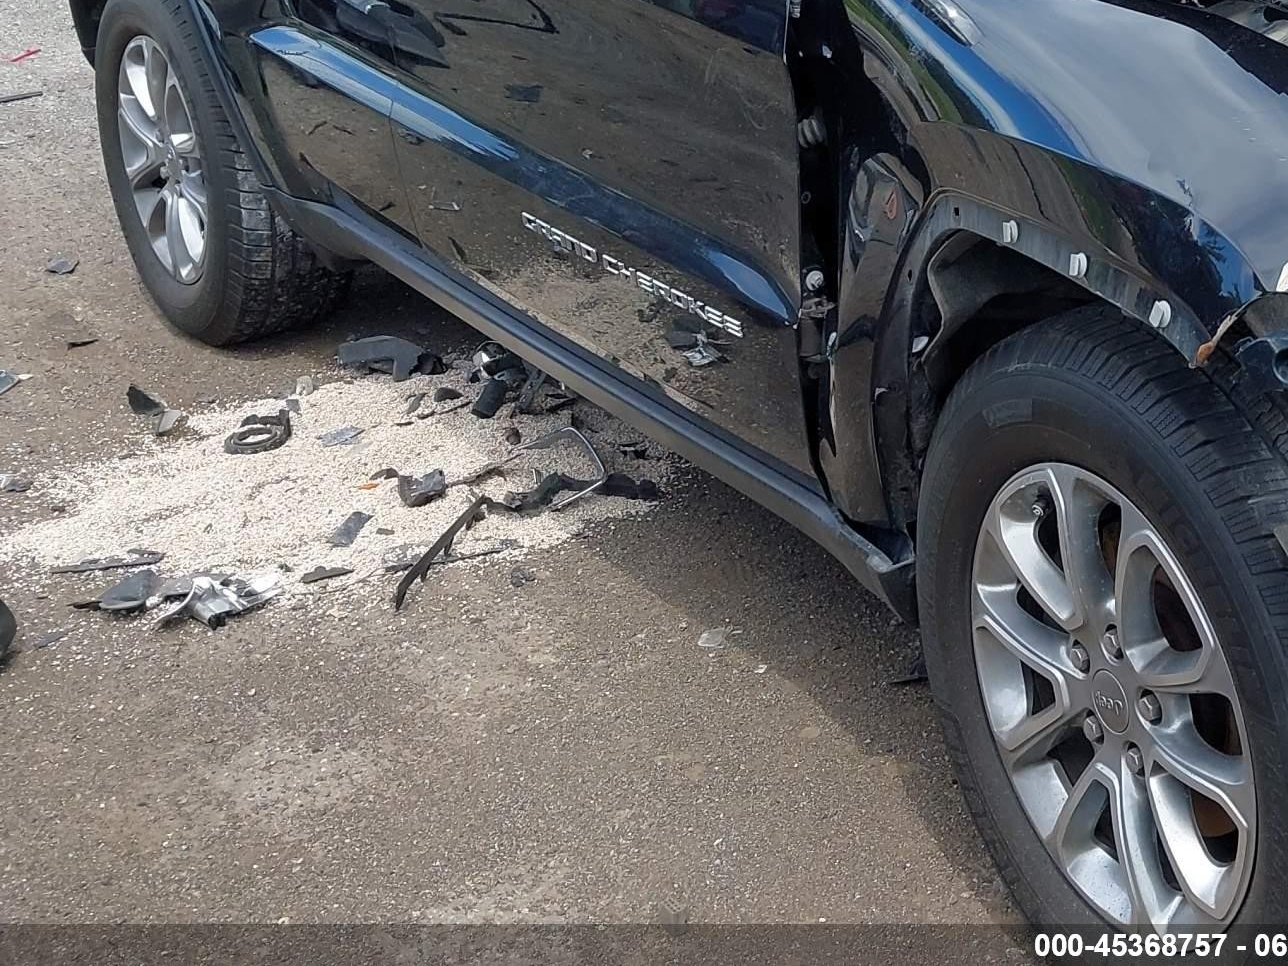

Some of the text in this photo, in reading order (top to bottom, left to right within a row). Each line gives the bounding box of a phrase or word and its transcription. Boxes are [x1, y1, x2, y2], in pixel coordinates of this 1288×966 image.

[521, 211, 744, 339] GRAND CHEROKEE
[1095, 689, 1123, 715] Jeep
